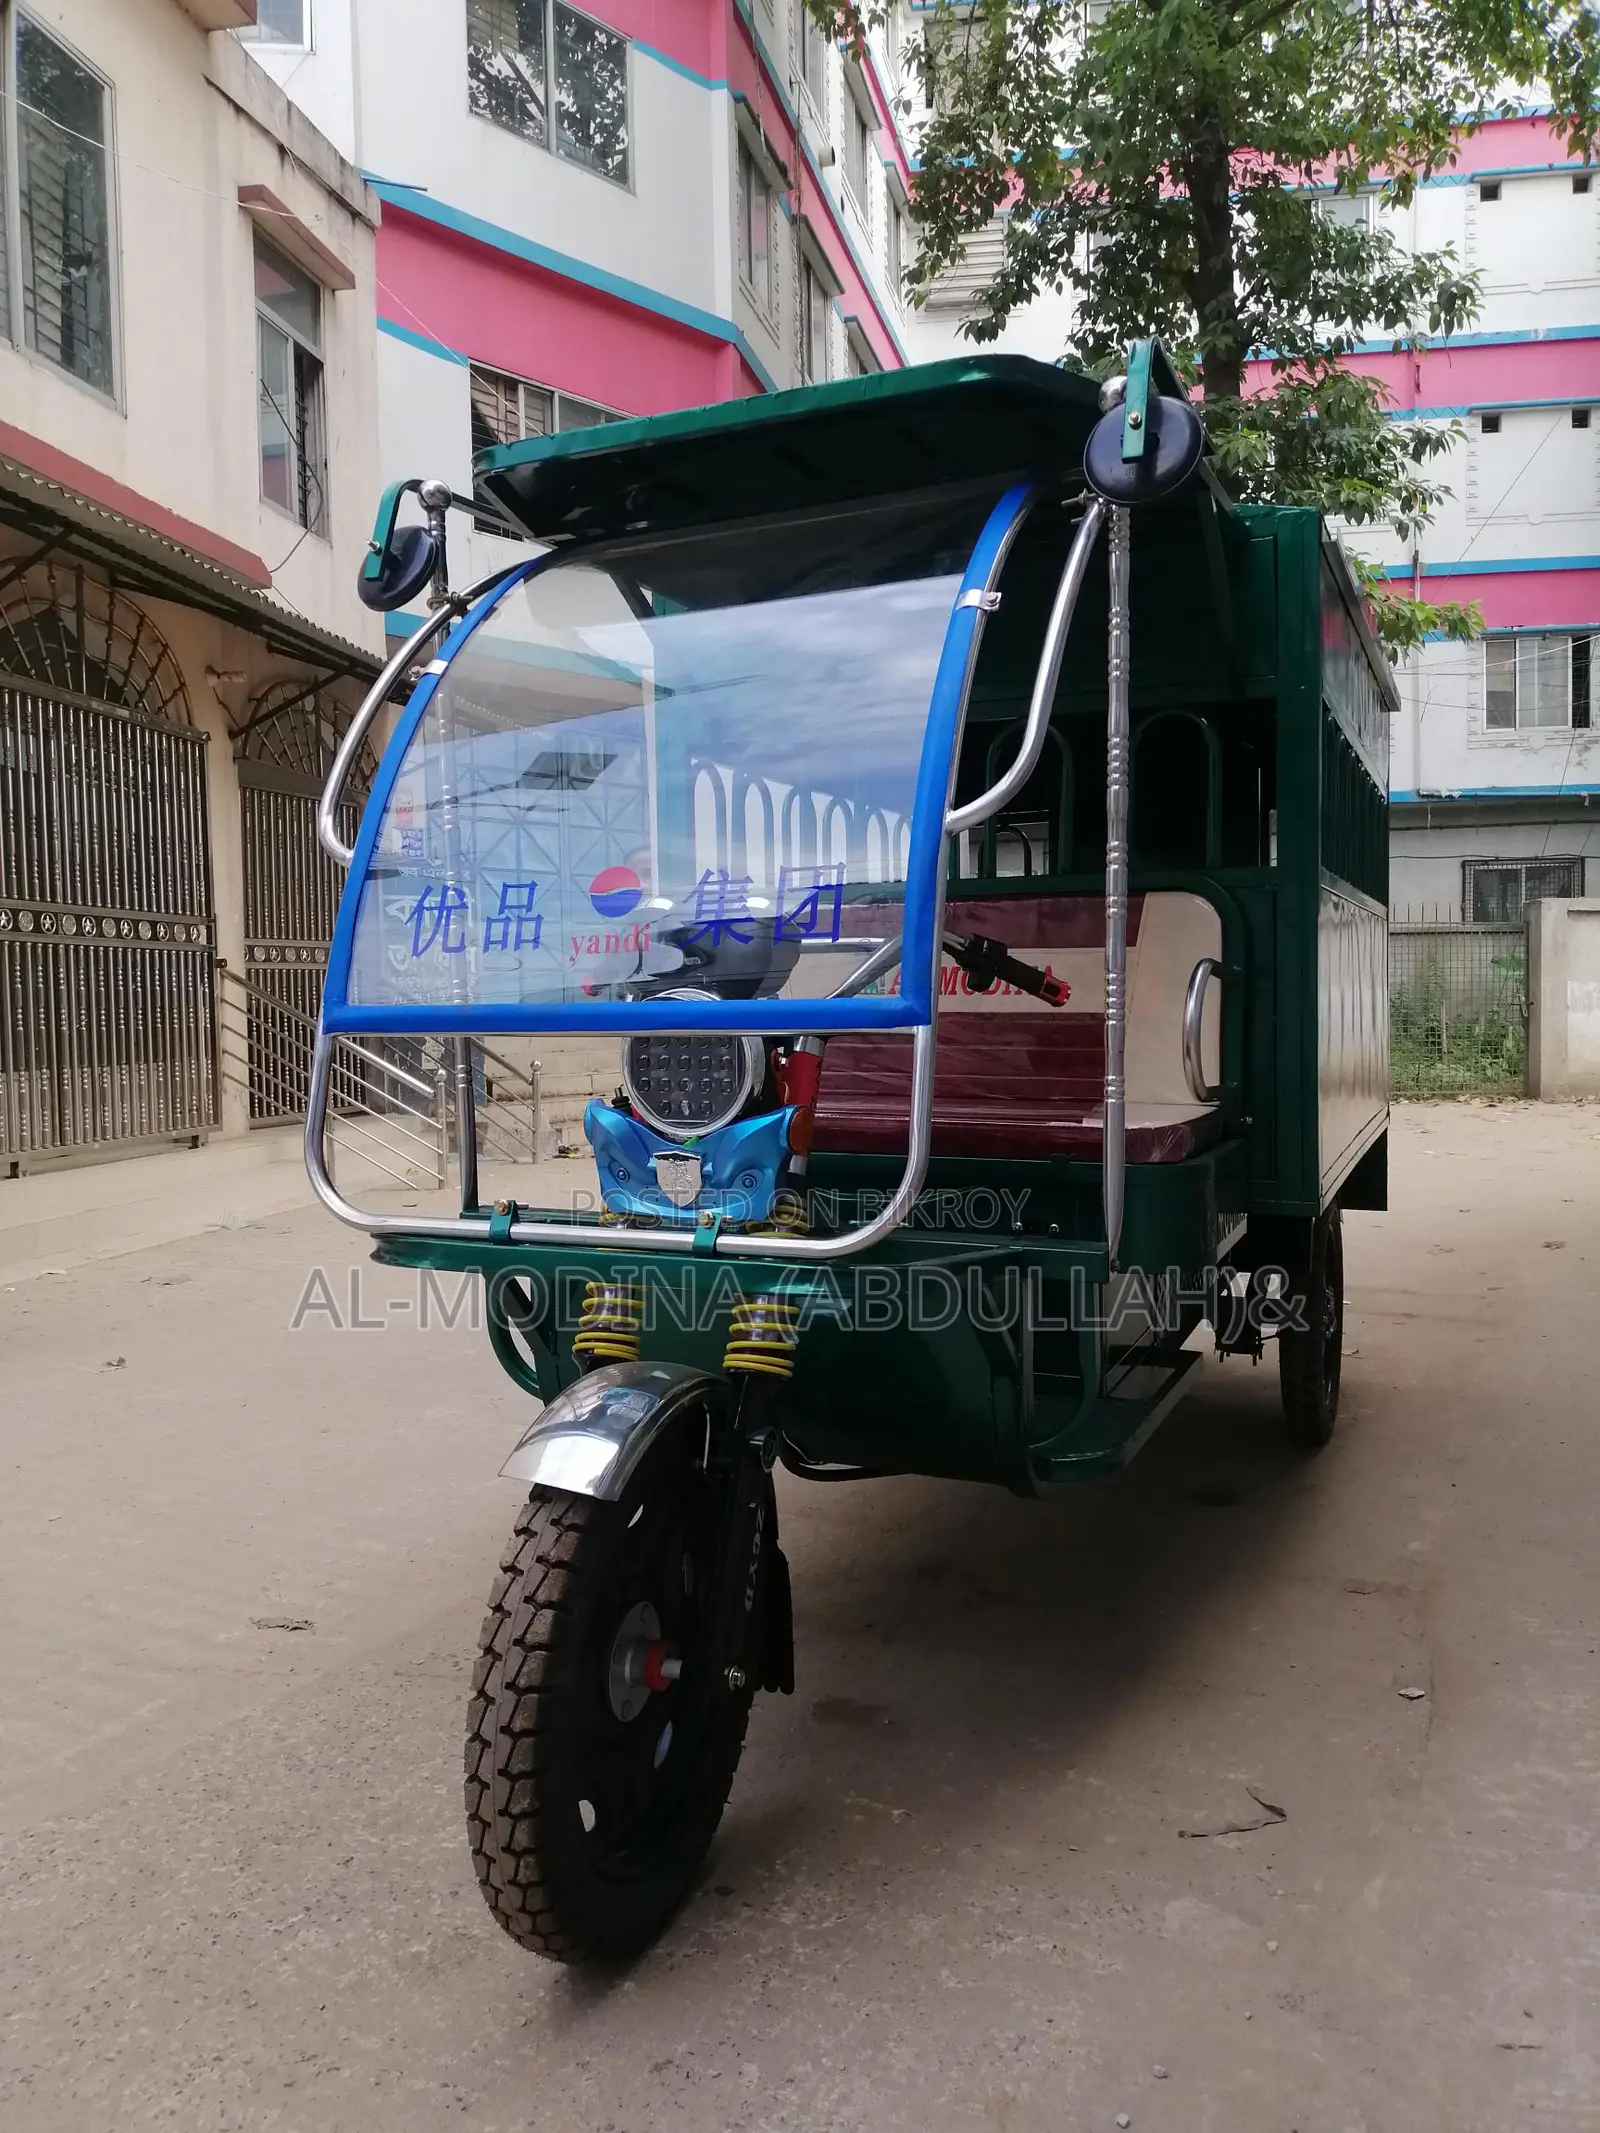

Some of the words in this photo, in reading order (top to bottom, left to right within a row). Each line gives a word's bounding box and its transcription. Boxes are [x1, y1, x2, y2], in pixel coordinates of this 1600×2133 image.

[404, 879, 545, 958] 优品
[680, 860, 848, 950] 集团
[568, 921, 651, 968] yandi
